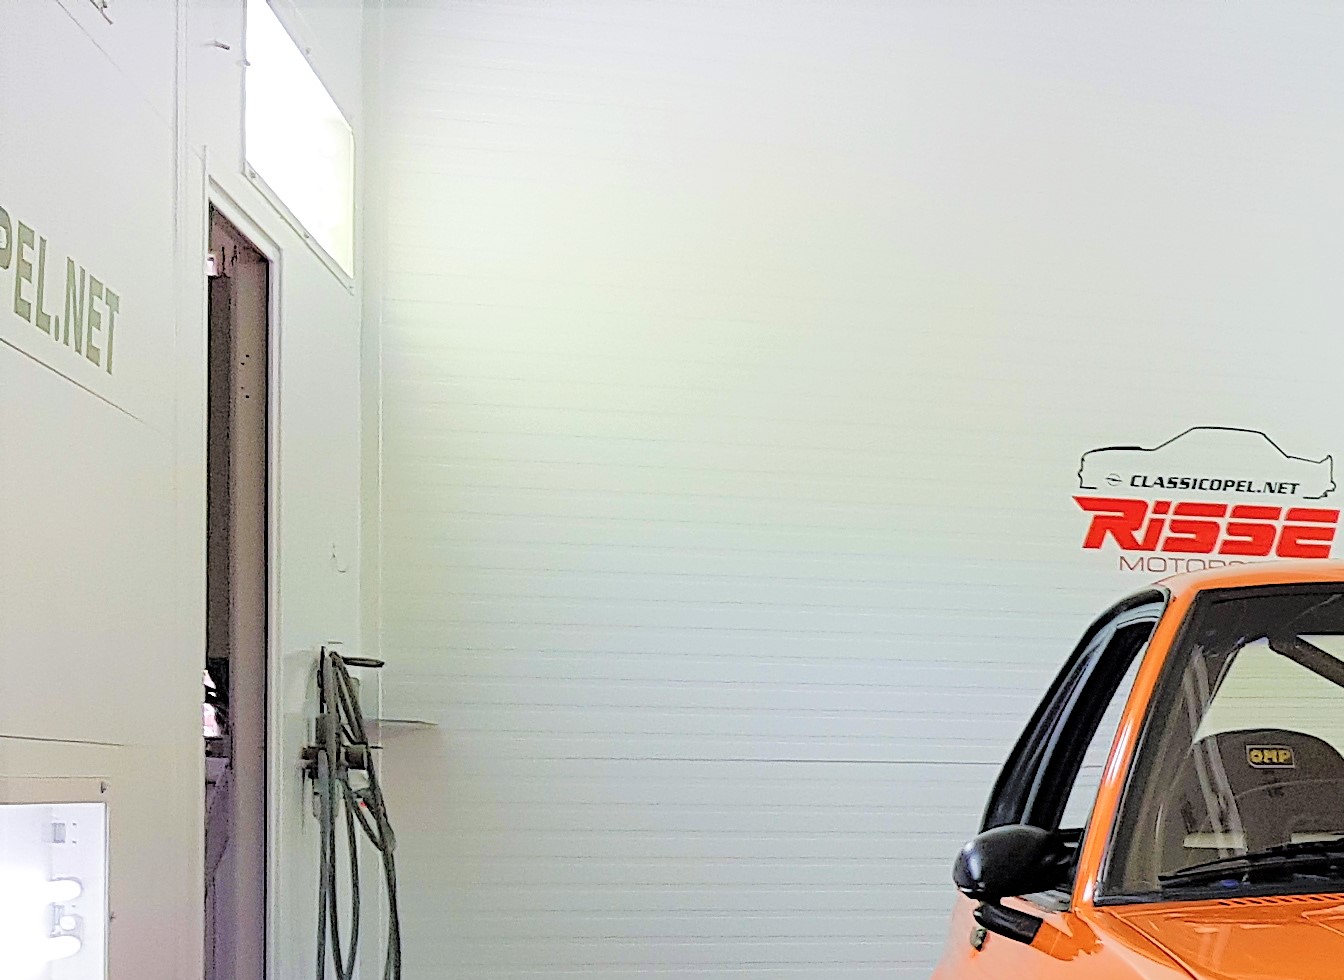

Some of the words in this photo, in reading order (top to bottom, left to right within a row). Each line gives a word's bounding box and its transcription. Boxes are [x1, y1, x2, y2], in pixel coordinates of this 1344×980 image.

[1130, 475, 1301, 495] CLASSICOPEL.NET
[1120, 556, 1244, 572] MOTO
[1250, 749, 1291, 763] OMP
